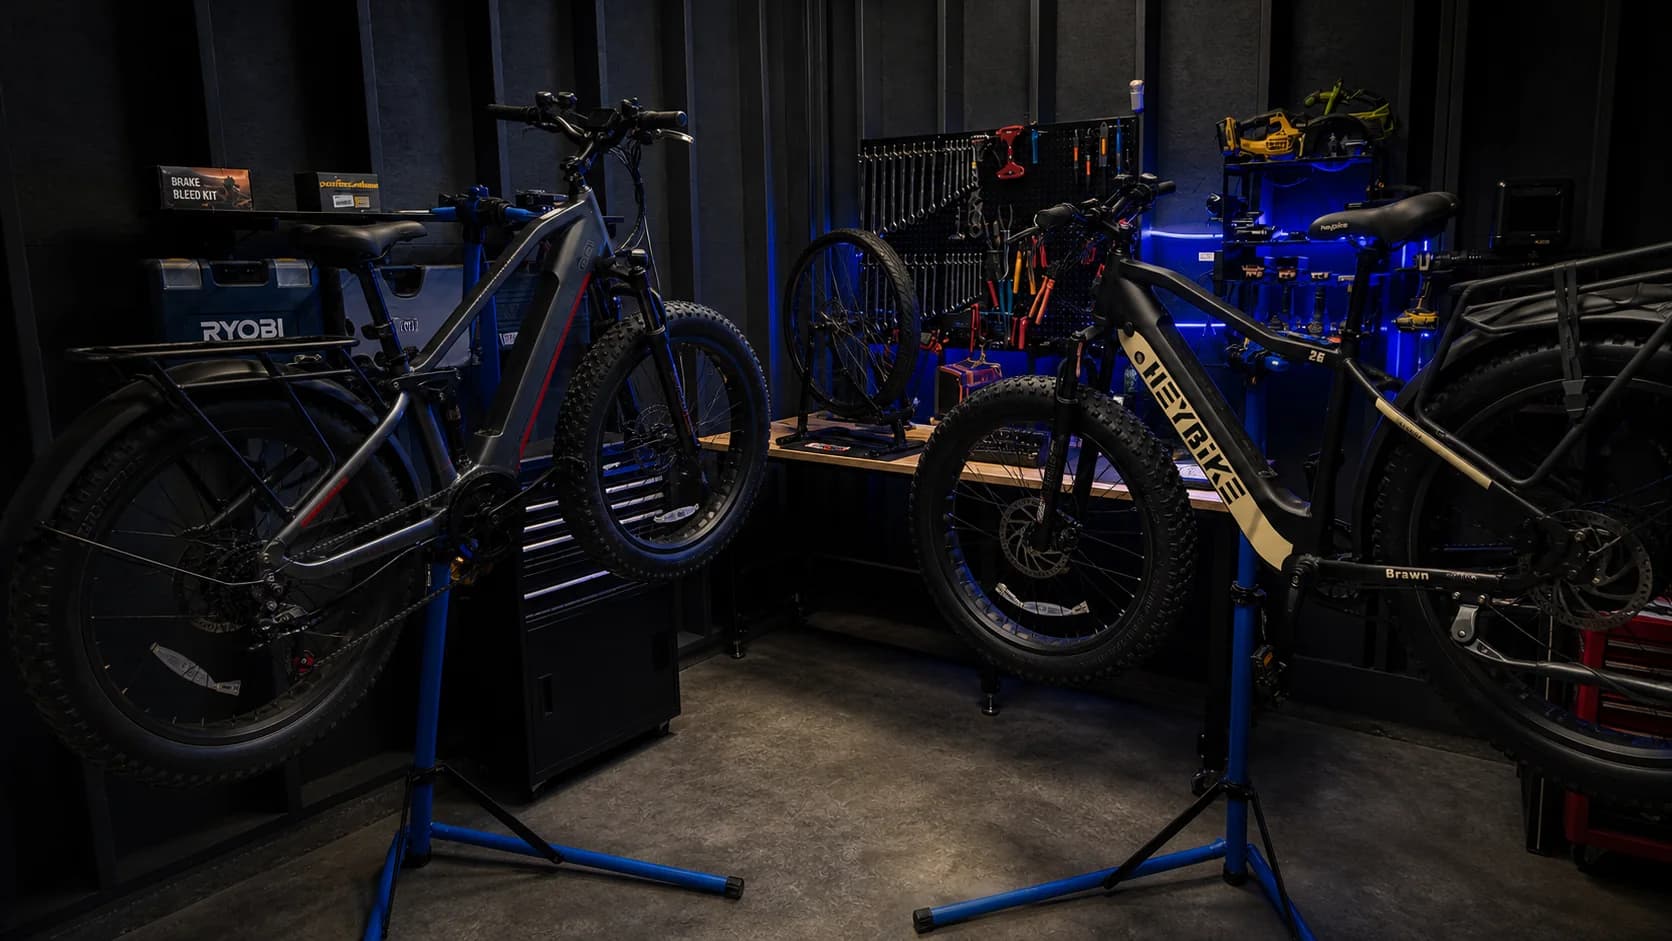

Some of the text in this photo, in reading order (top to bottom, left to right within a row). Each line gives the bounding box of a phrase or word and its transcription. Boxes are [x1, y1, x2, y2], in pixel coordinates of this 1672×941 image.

[171, 176, 201, 188] BRAKE
[173, 189, 217, 201] BLEED KIT
[200, 317, 284, 341] RYOBI
[1308, 349, 1326, 364] 26
[1385, 568, 1430, 581] Brawn
